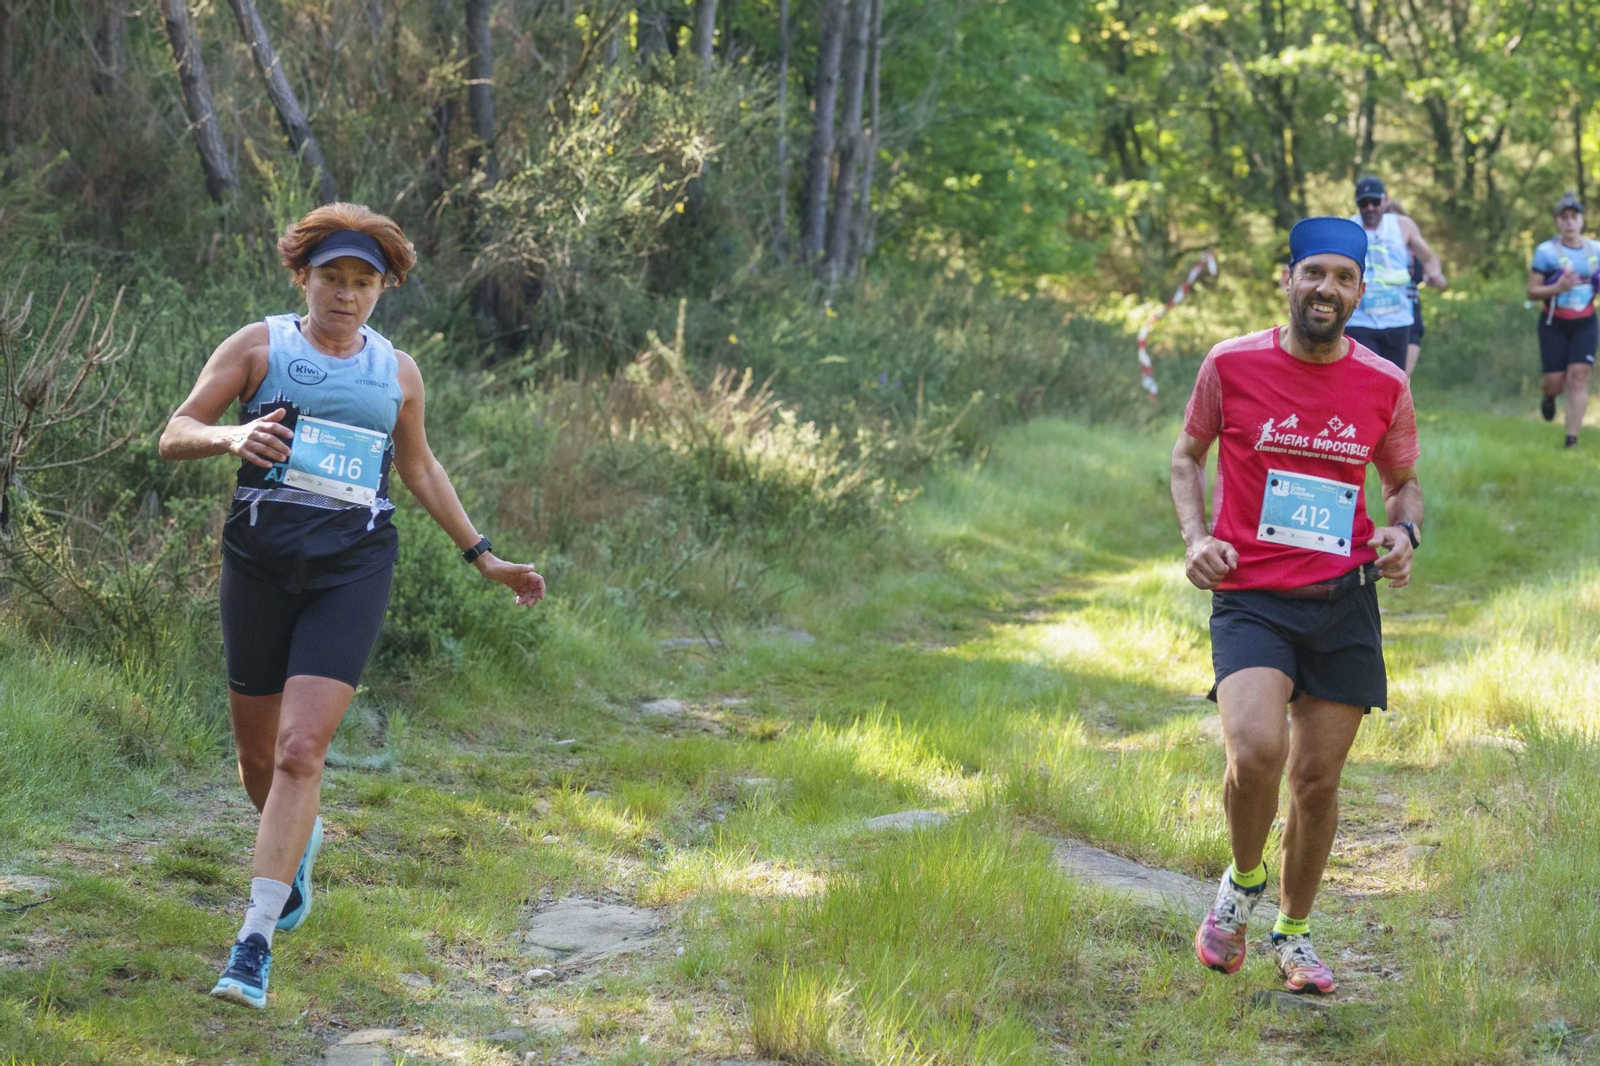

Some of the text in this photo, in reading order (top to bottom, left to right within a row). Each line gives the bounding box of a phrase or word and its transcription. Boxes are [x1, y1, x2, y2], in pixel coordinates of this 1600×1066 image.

[295, 364, 320, 376] Kiwi
[1273, 432, 1371, 458] METAS IMPOSIBLES
[318, 453, 363, 480] 416
[1291, 504, 1331, 530] 412
